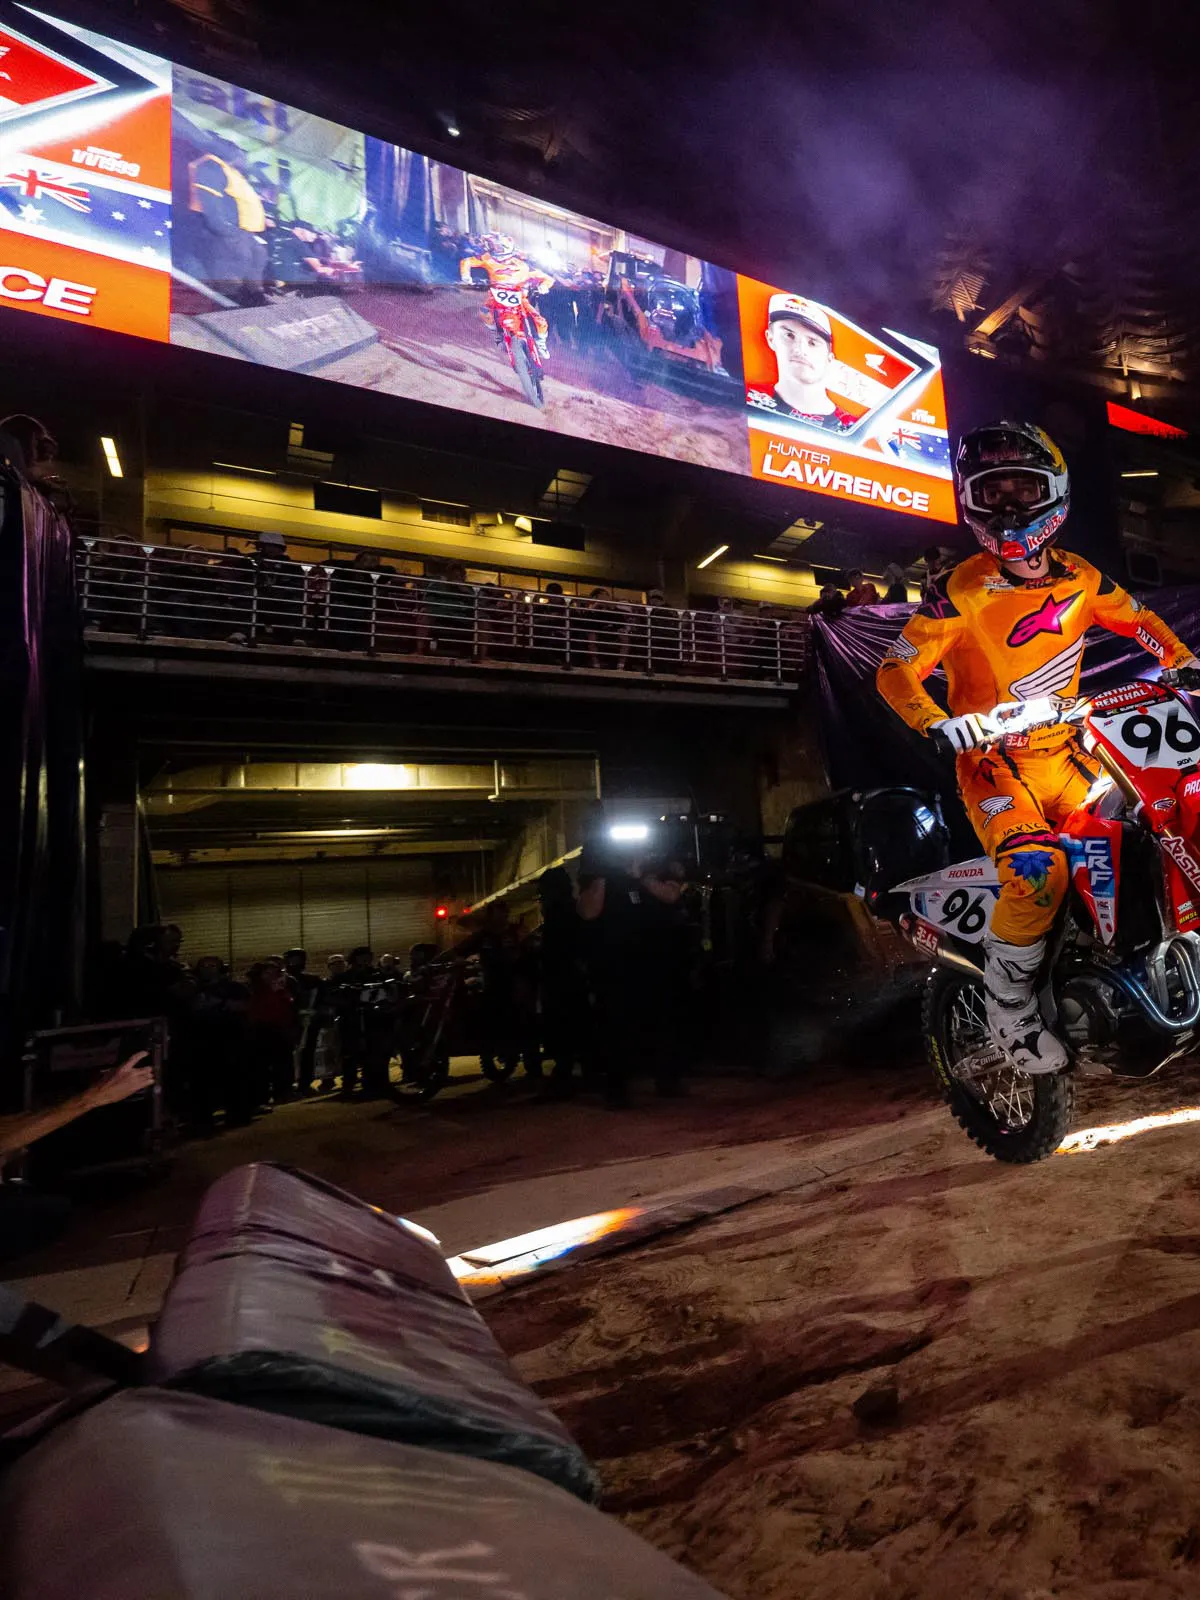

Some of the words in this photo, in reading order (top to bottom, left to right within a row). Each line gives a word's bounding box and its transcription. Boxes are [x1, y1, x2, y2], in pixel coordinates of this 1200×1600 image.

[497, 291, 519, 304] 96
[769, 440, 830, 466] HUNTER
[762, 454, 930, 512] LAWRENCE
[1025, 519, 1053, 551] Red
[1095, 689, 1149, 708] RENTHAL
[948, 867, 985, 879] HONDA
[1085, 839, 1113, 886] CRF
[937, 888, 988, 934] 96
